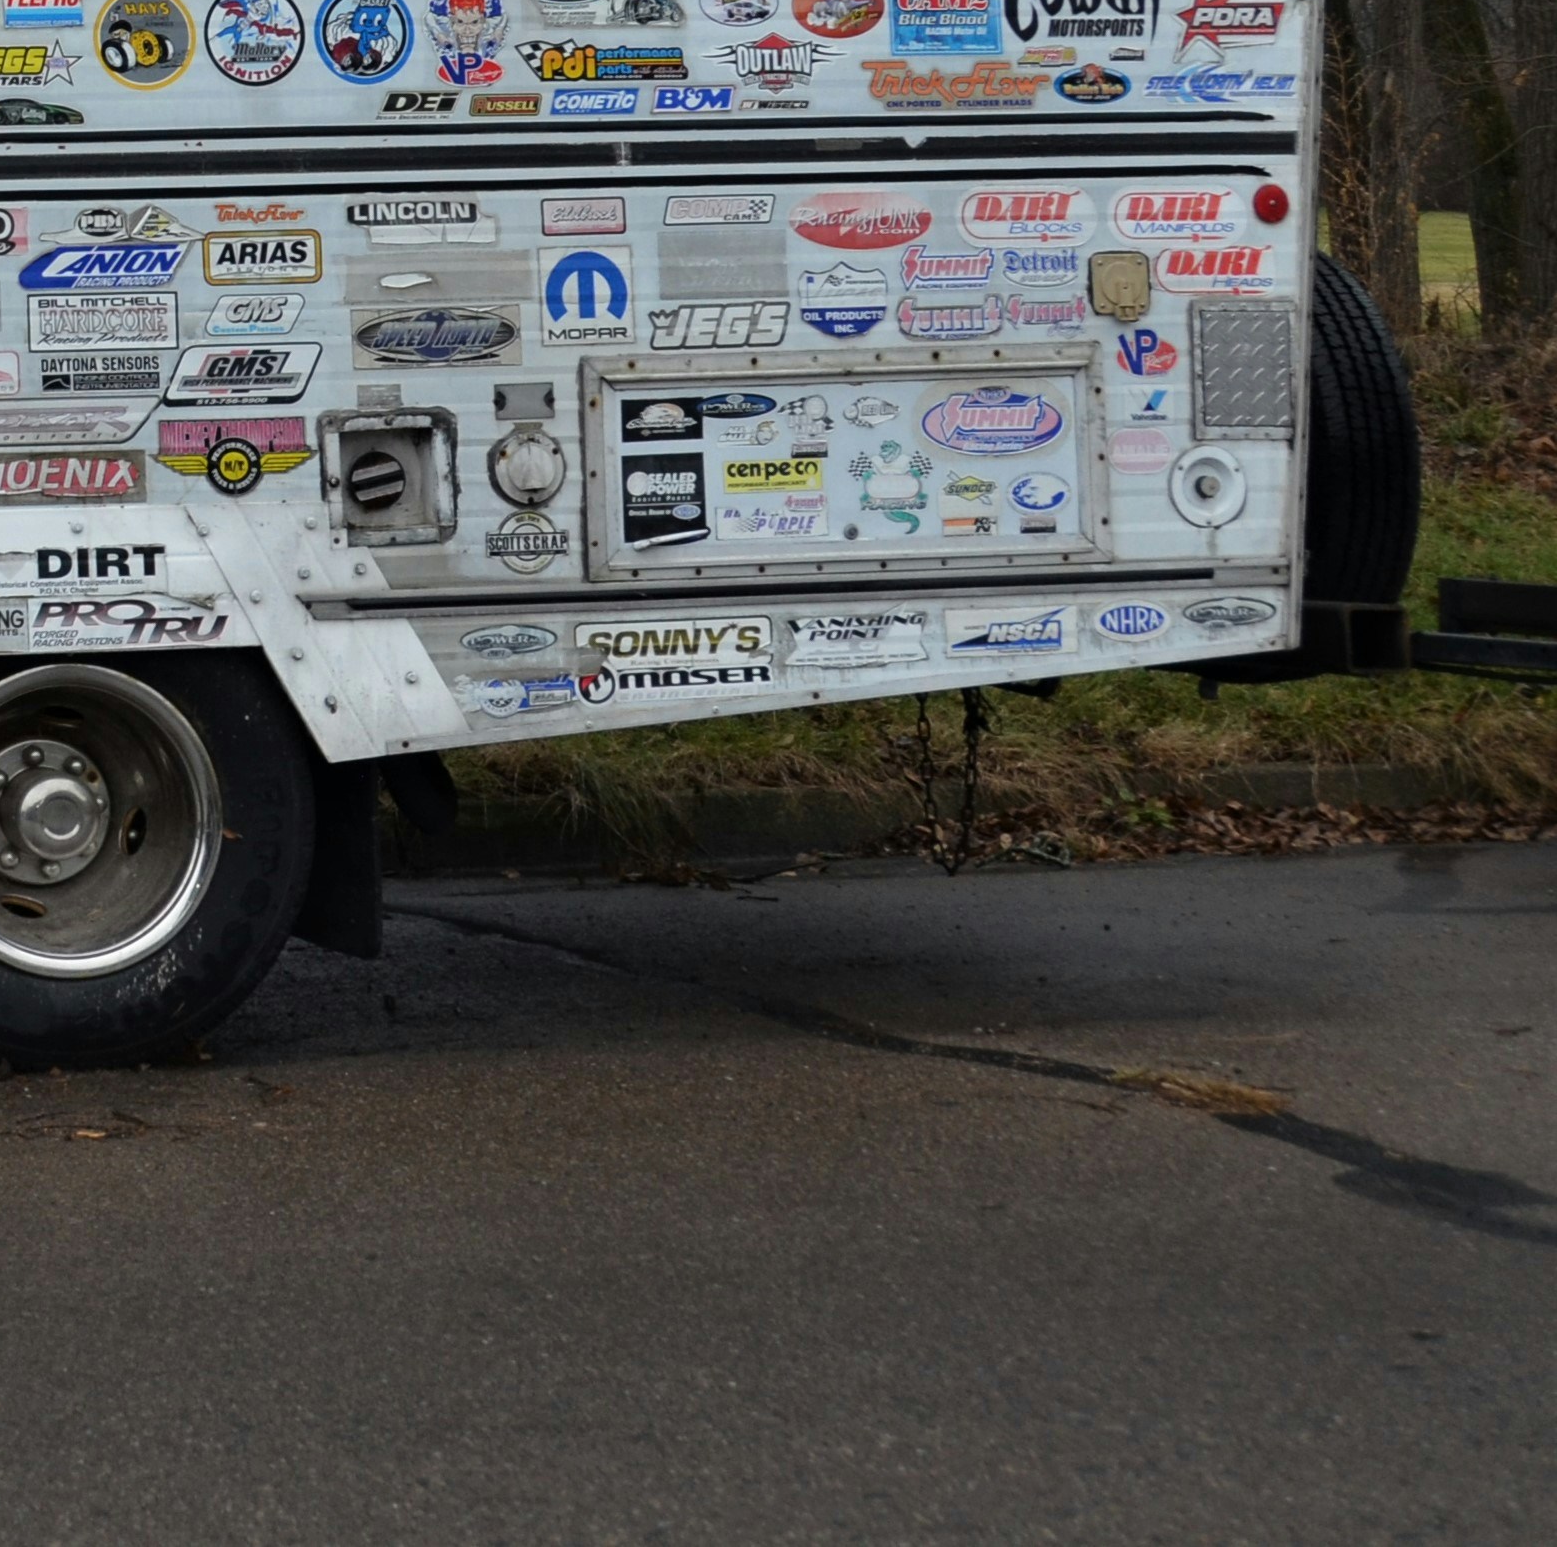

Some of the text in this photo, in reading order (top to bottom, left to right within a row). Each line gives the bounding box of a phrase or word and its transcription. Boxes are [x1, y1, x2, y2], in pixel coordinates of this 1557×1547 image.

[898, 14, 987, 26] Blue Blood
[1048, 19, 1145, 37] MOTORSPORTS
[1193, 7, 1275, 26] PDRA
[441, 53, 484, 85] VP
[737, 43, 813, 74] OUTLAW
[862, 61, 1050, 102] Trick Flow
[473, 97, 537, 115] RUSSELL
[555, 92, 635, 112] COMETIC
[655, 88, 731, 110] B&M
[353, 202, 471, 222] LINCOLN
[972, 193, 1071, 221] DART
[1125, 192, 1223, 220] DART
[1009, 222, 1083, 234] BLOCKS
[1134, 221, 1235, 234] MANIFOLDS
[217, 240, 307, 266] ARIAS
[1165, 247, 1263, 277] DART
[1213, 276, 1273, 288] HEADS
[548, 328, 629, 340] MOPAR
[41, 356, 160, 373] DAYTONA SENSORS
[37, 546, 166, 579] DIRT
[34, 600, 157, 628] PRO
[1104, 608, 1160, 635] NHRA
[125, 615, 230, 645] TRU
[588, 624, 761, 658] SONNY'S
[617, 664, 771, 691] MOSER
